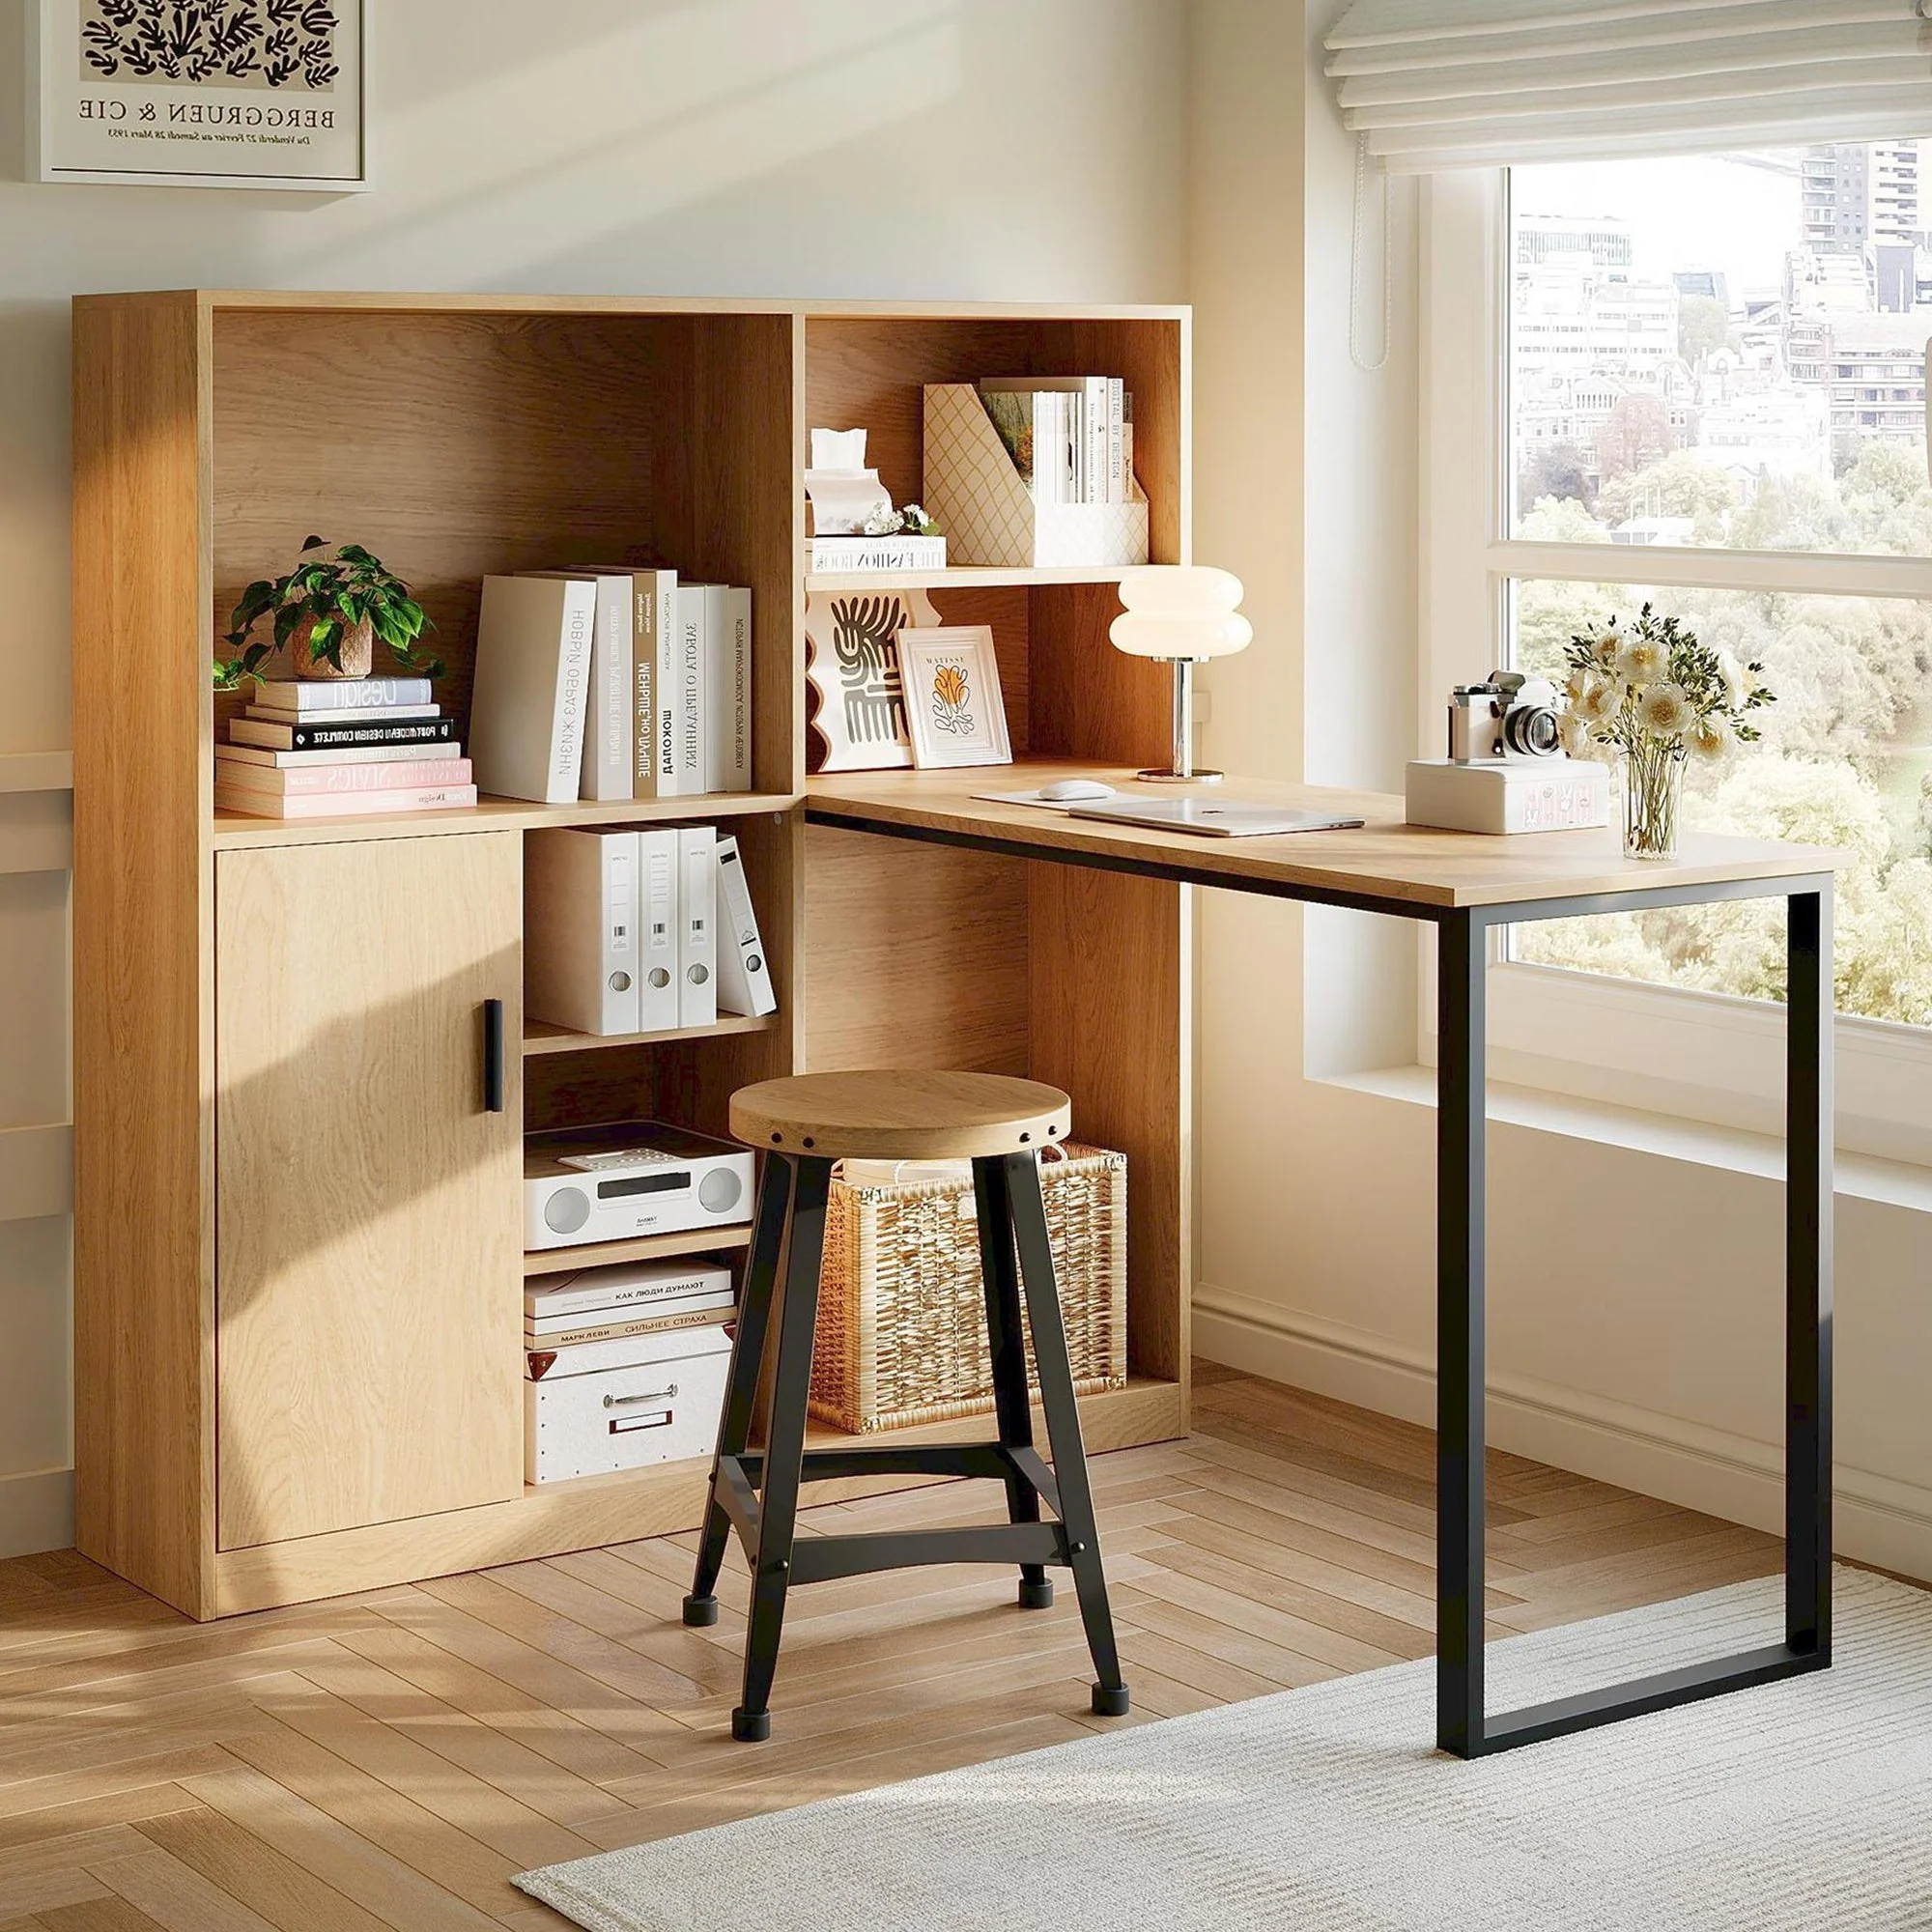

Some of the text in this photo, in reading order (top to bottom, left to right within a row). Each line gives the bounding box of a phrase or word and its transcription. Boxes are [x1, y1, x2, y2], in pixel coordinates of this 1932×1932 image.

[1112, 425, 1119, 437] BY
[636, 1287, 663, 1297] ЛЮДИ
[665, 1281, 704, 1293] ДУМАЮТ
[560, 1315, 707, 1342] МАРК ЛЕВИ СИЛЬНЕЕ СТРАХА
